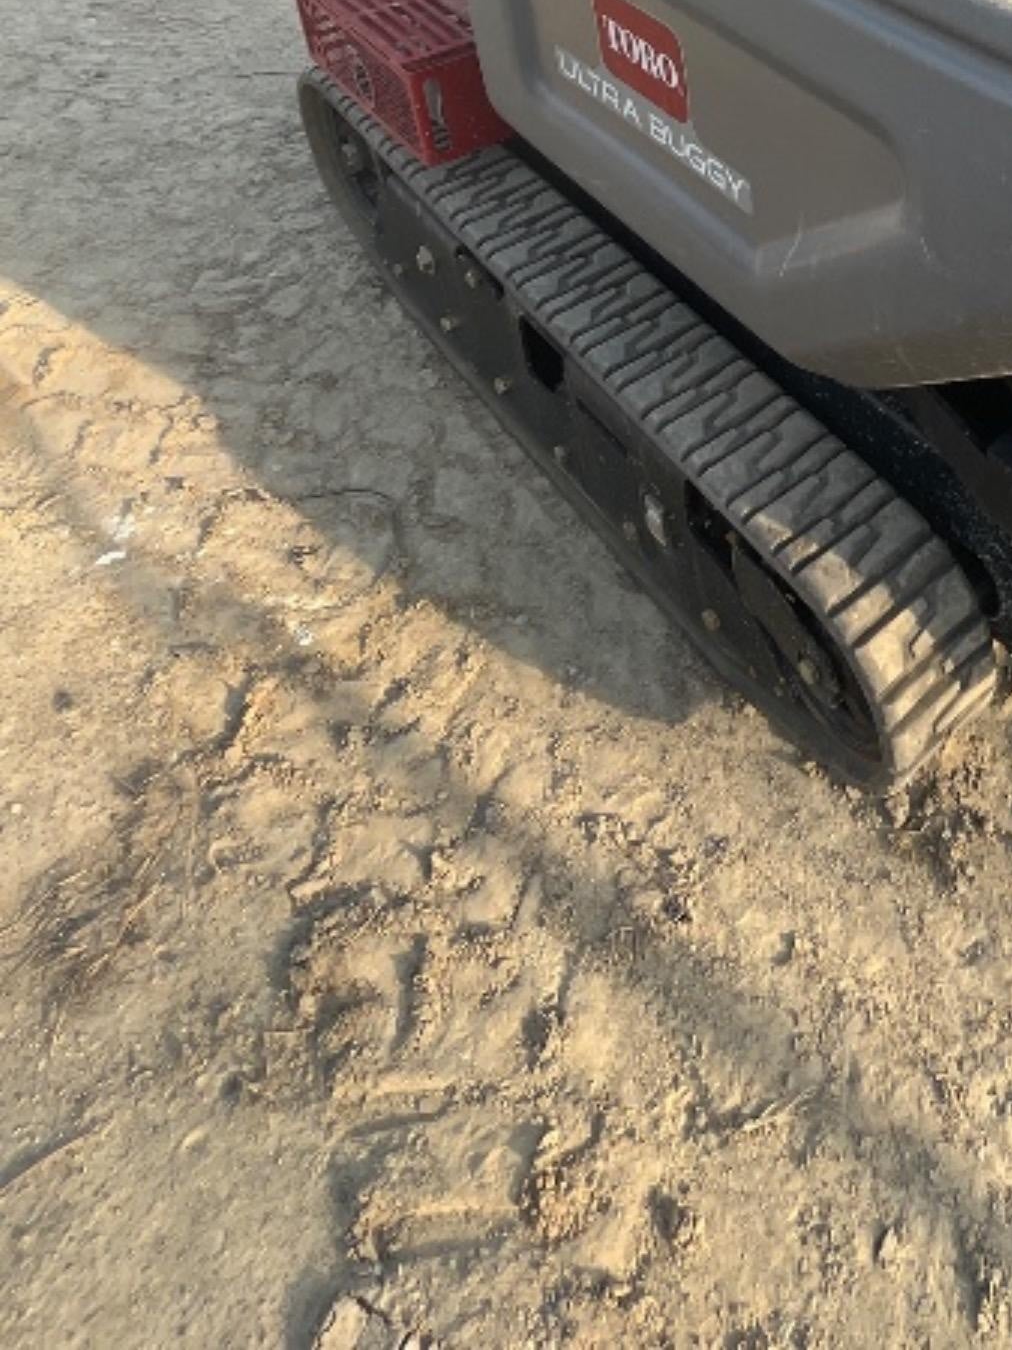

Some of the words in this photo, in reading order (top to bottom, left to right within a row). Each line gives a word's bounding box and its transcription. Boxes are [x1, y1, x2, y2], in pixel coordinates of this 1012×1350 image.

[602, 14, 681, 89] TORO
[554, 44, 643, 130] ULTRA
[649, 113, 746, 201] BUGGY
